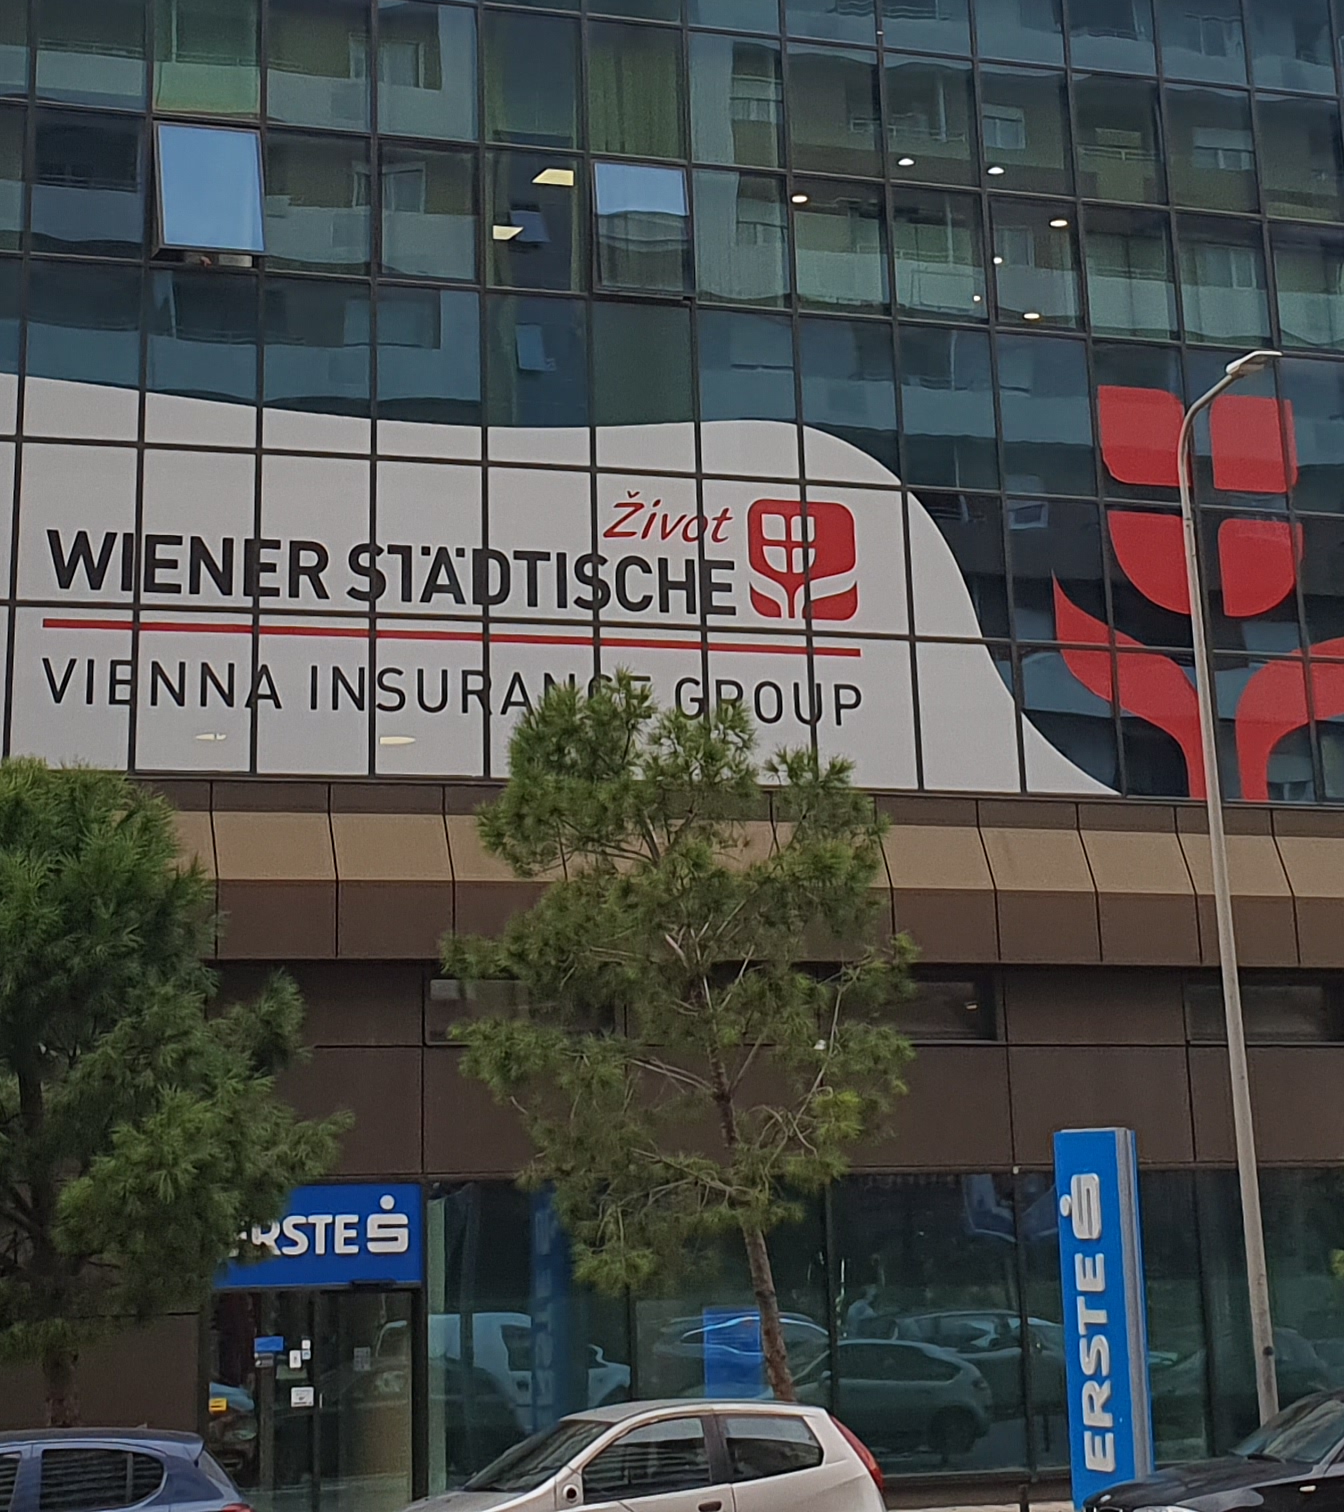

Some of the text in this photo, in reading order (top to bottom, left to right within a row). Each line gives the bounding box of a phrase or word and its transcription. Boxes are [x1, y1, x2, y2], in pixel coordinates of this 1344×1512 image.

[603, 490, 733, 543] Život
[46, 529, 737, 616] WIENER STÄDTISCHE
[42, 657, 282, 710] VIENNA
[674, 676, 862, 727] GROUP
[1073, 1252, 1116, 1473] ERSTE
